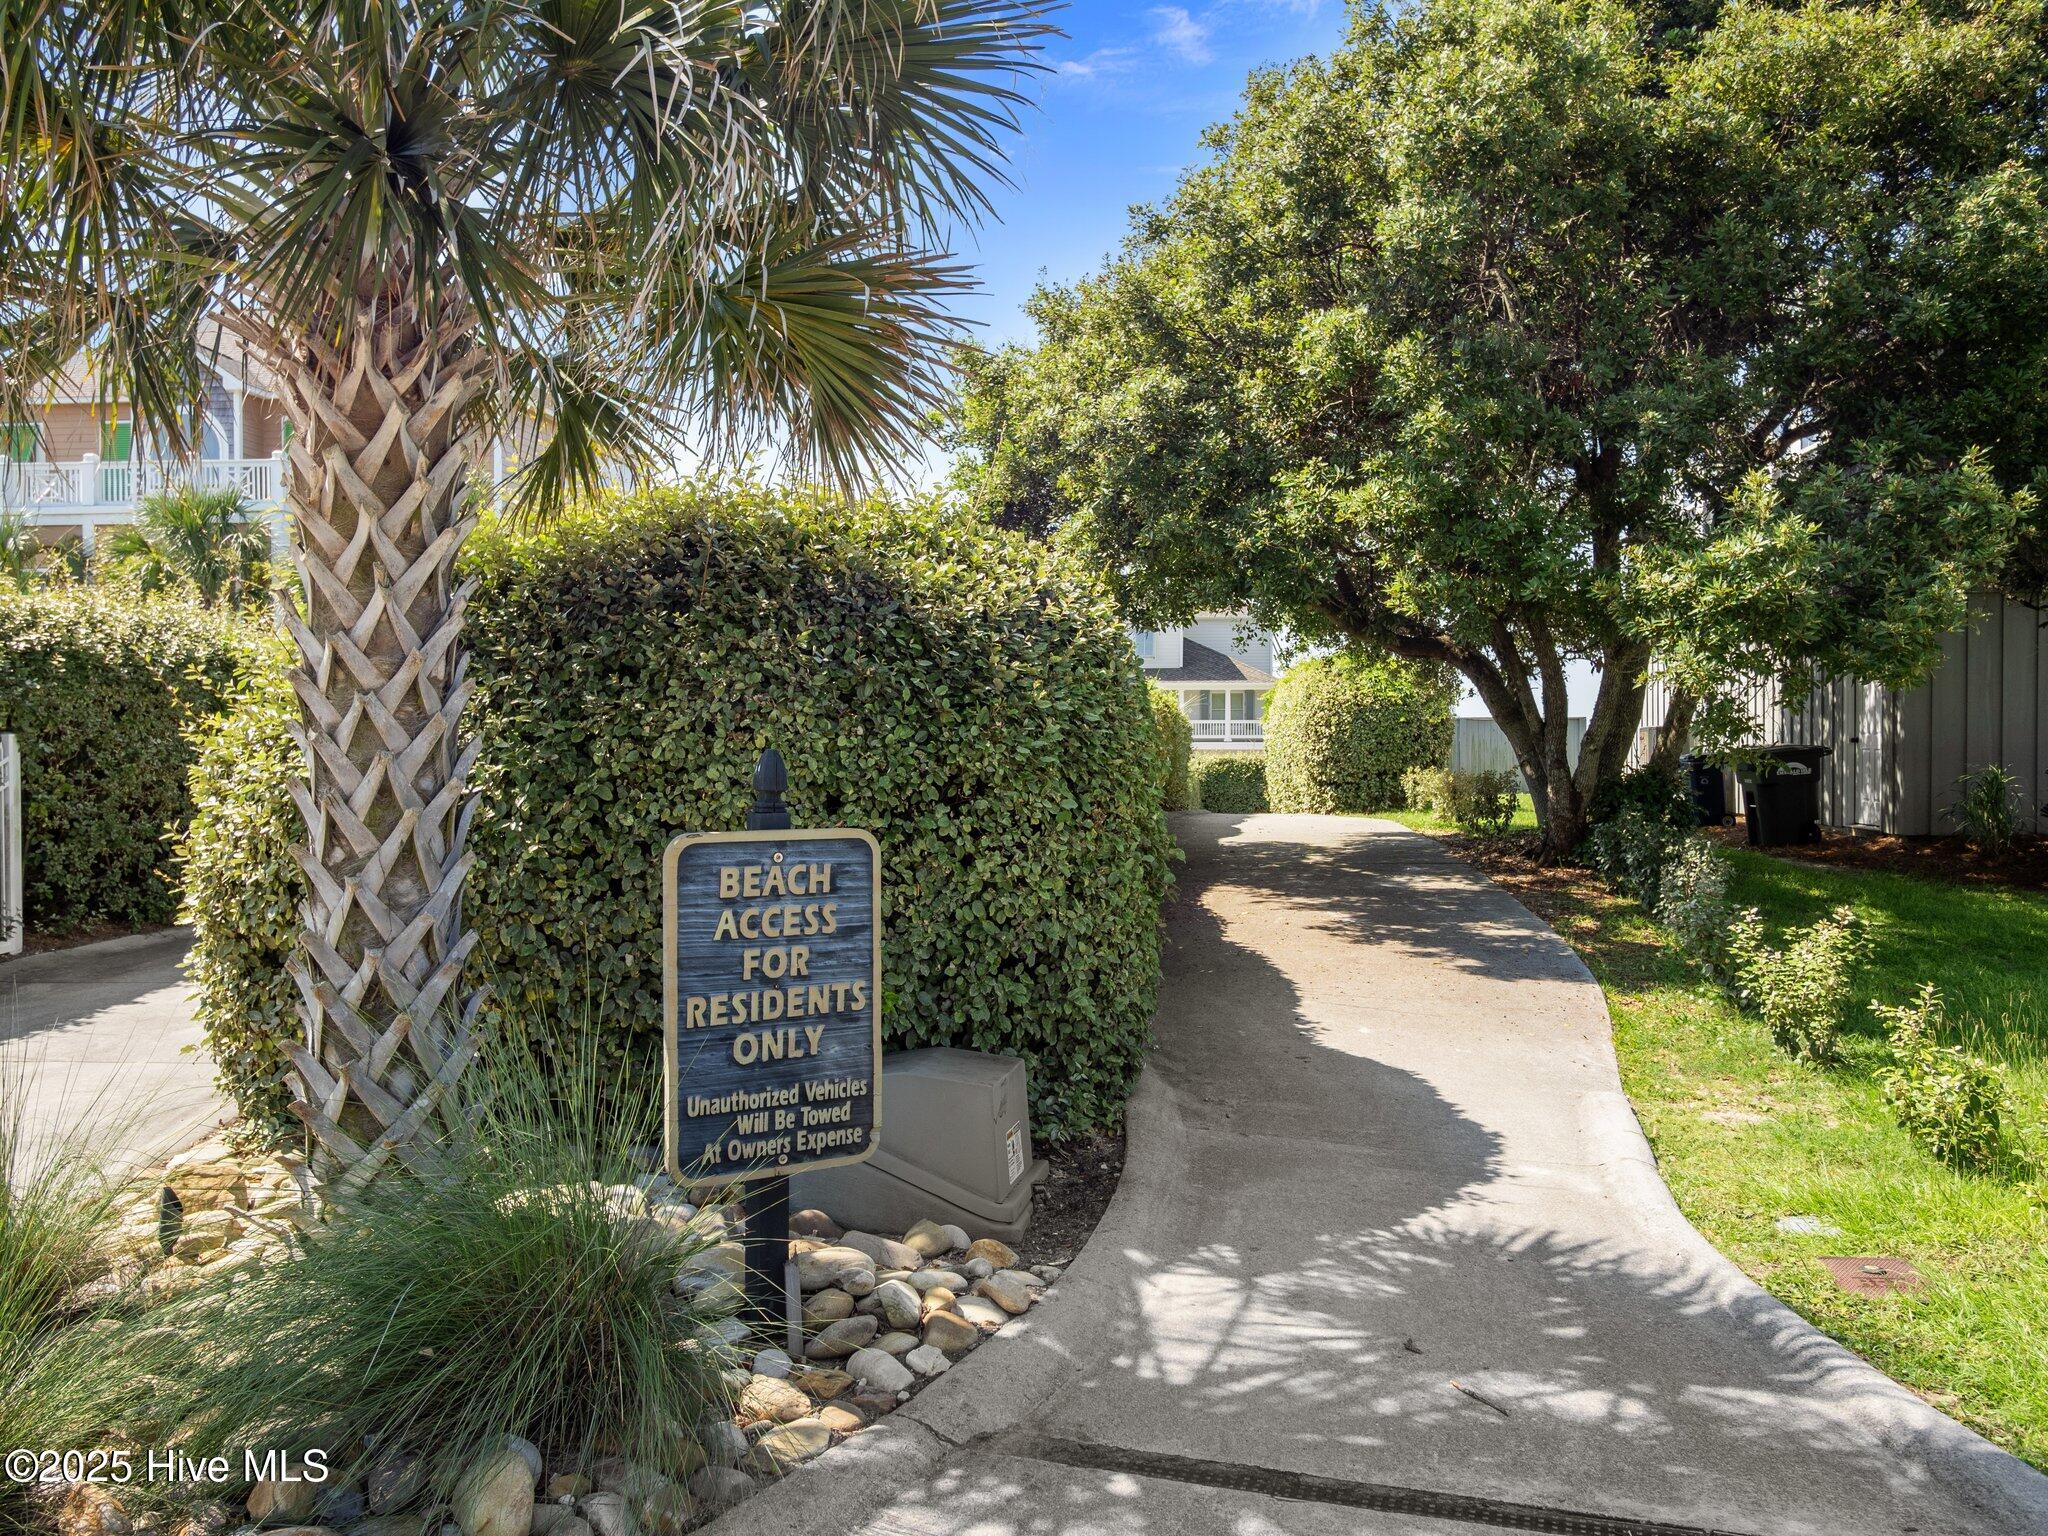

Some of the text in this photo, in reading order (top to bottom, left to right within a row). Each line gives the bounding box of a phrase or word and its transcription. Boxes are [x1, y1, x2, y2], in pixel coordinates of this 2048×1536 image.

[720, 864, 832, 899] BEACH
[713, 902, 838, 940] ACCESS
[742, 946, 810, 980] FOR
[686, 980, 867, 1029] RESIDENTS
[733, 1024, 826, 1066] ONLY
[687, 1078, 868, 1118] Unauthorized Vehicles
[736, 1101, 851, 1135] Will Be Towed
[702, 1126, 863, 1164] At Owners Expense
